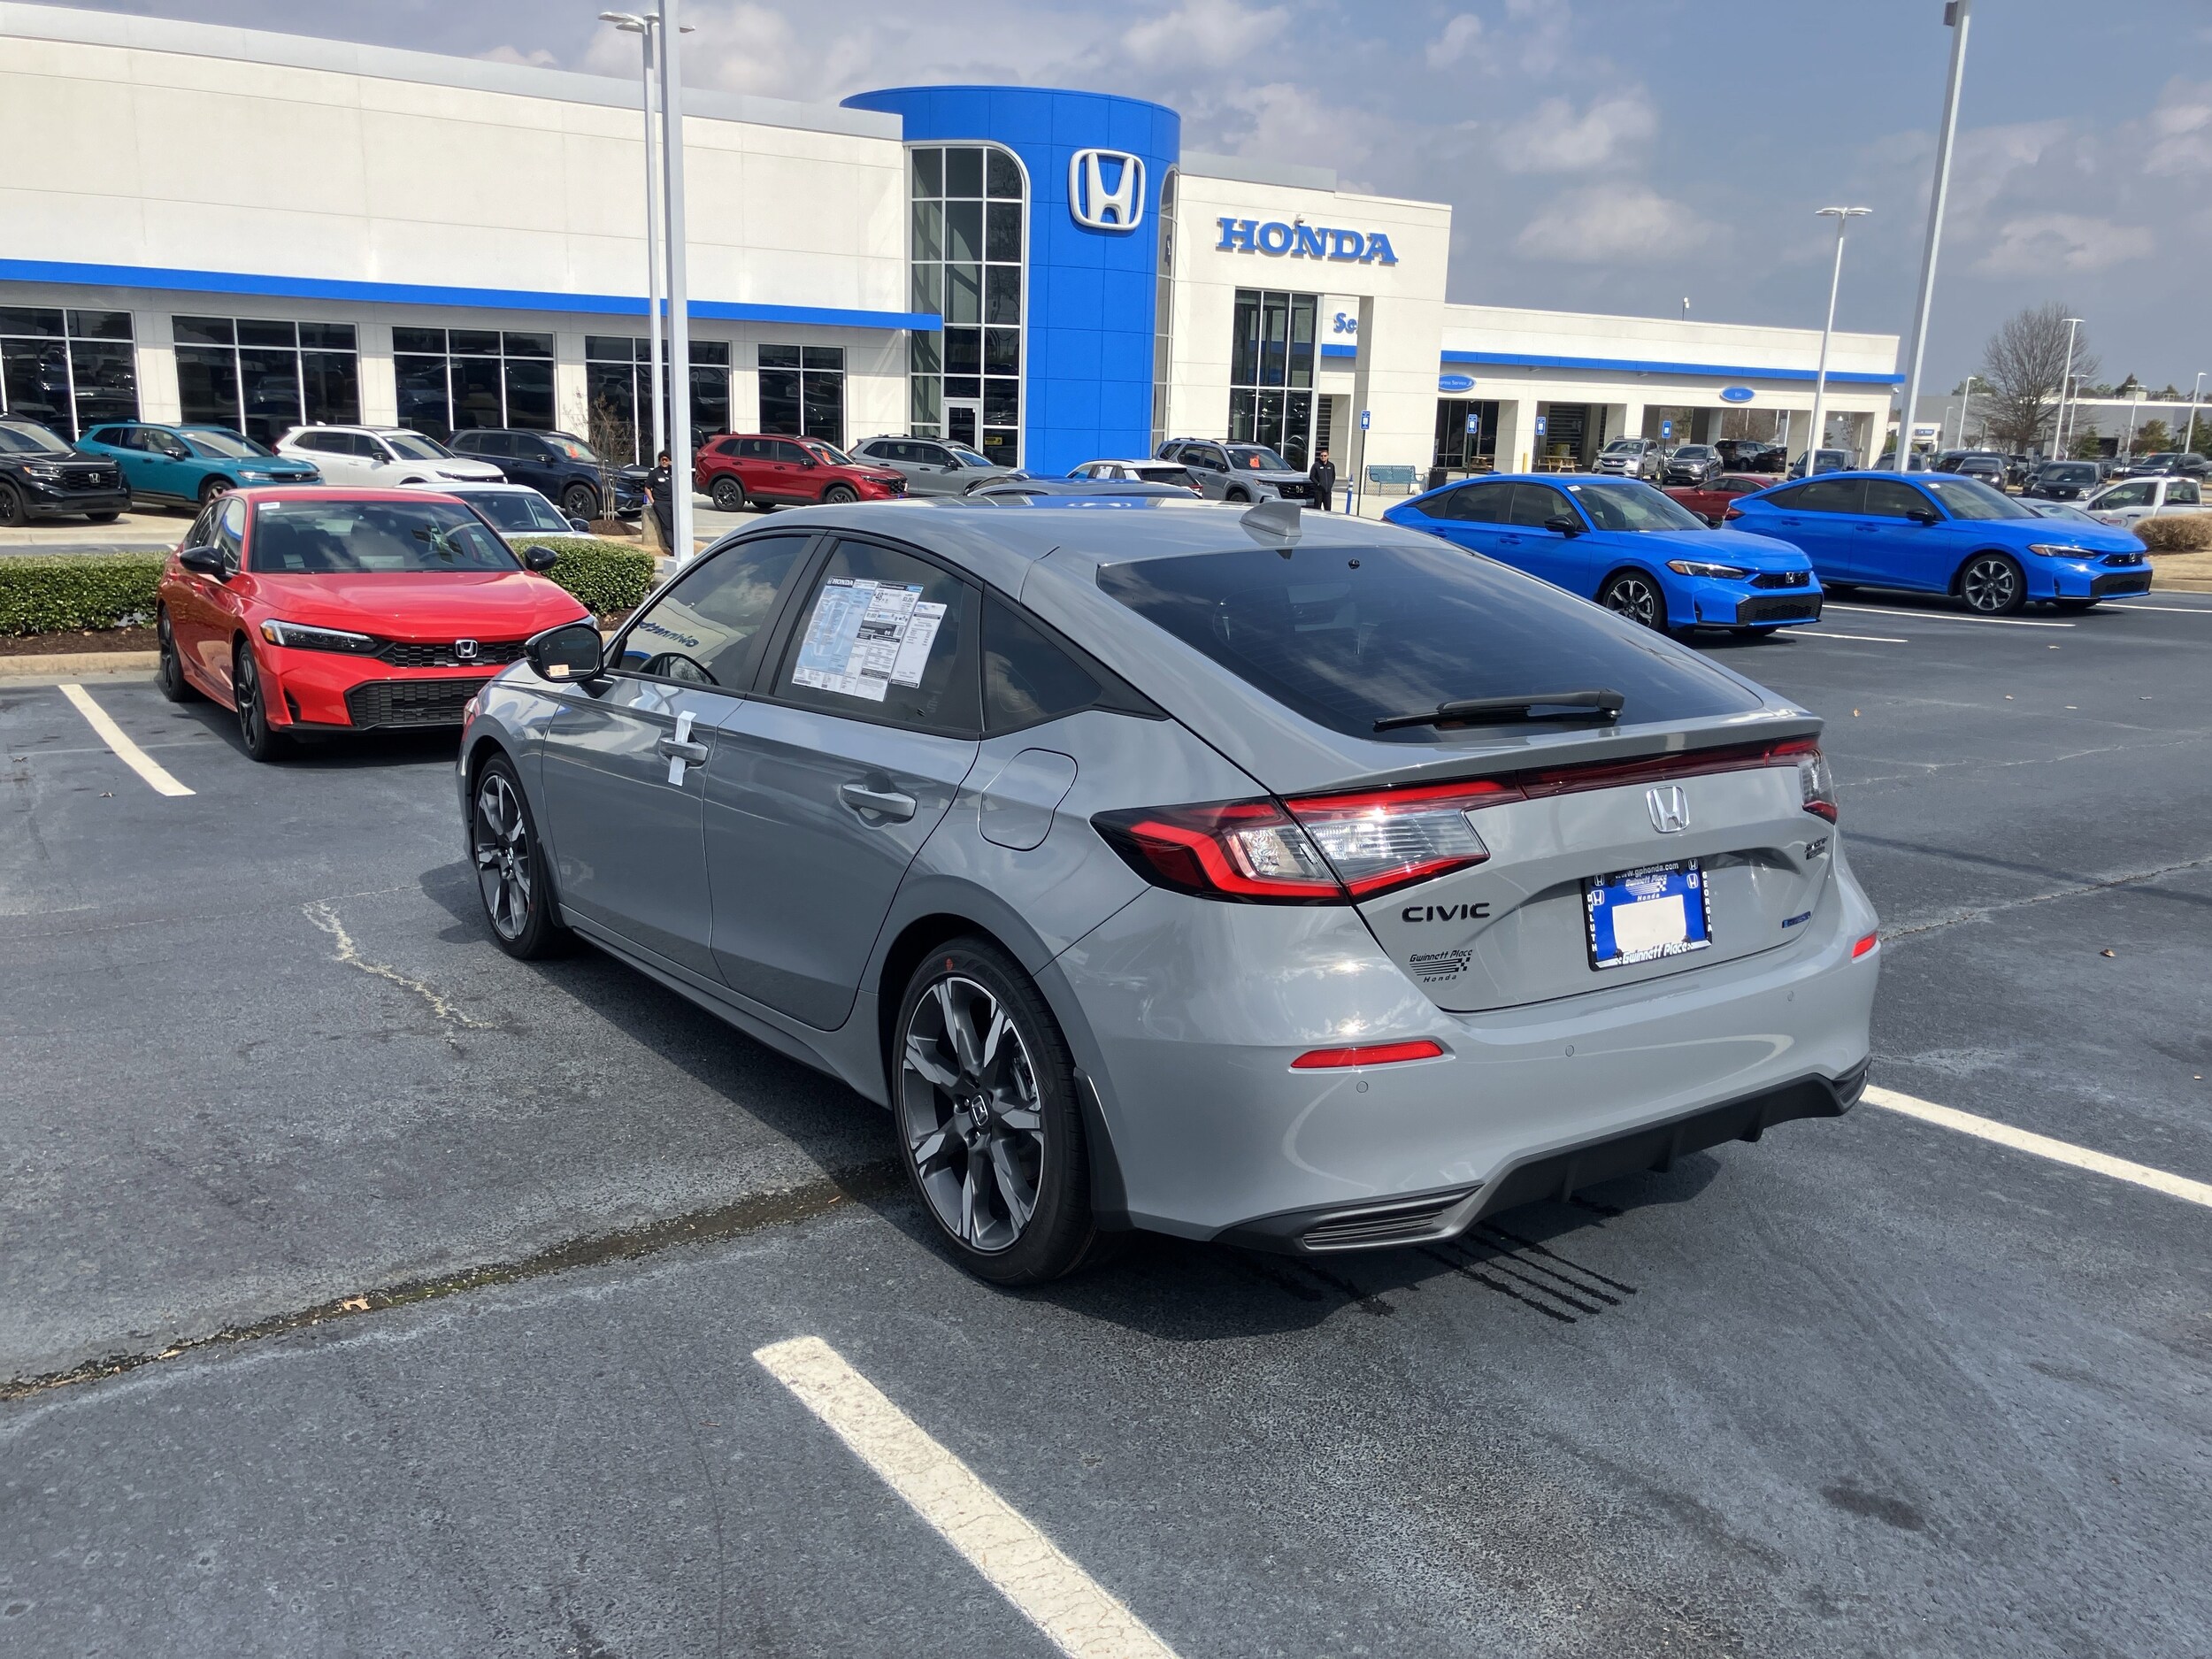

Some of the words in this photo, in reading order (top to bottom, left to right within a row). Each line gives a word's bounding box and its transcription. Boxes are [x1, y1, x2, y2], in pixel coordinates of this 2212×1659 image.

[1217, 217, 1399, 265] HONDA
[1334, 312, 1357, 334] Se
[1651, 874, 1667, 883] Place
[1637, 893, 1660, 902] Honda
[1701, 871, 1713, 933] GEORGIA
[1402, 902, 1490, 923] CIVIC
[1586, 894, 1598, 952] DULUTH
[1409, 951, 1449, 963] Gwinnett
[1449, 949, 1473, 958] Place
[1622, 945, 1663, 964] Gwinnett
[1663, 942, 1688, 956] Place
[1423, 974, 1457, 983] Honda
